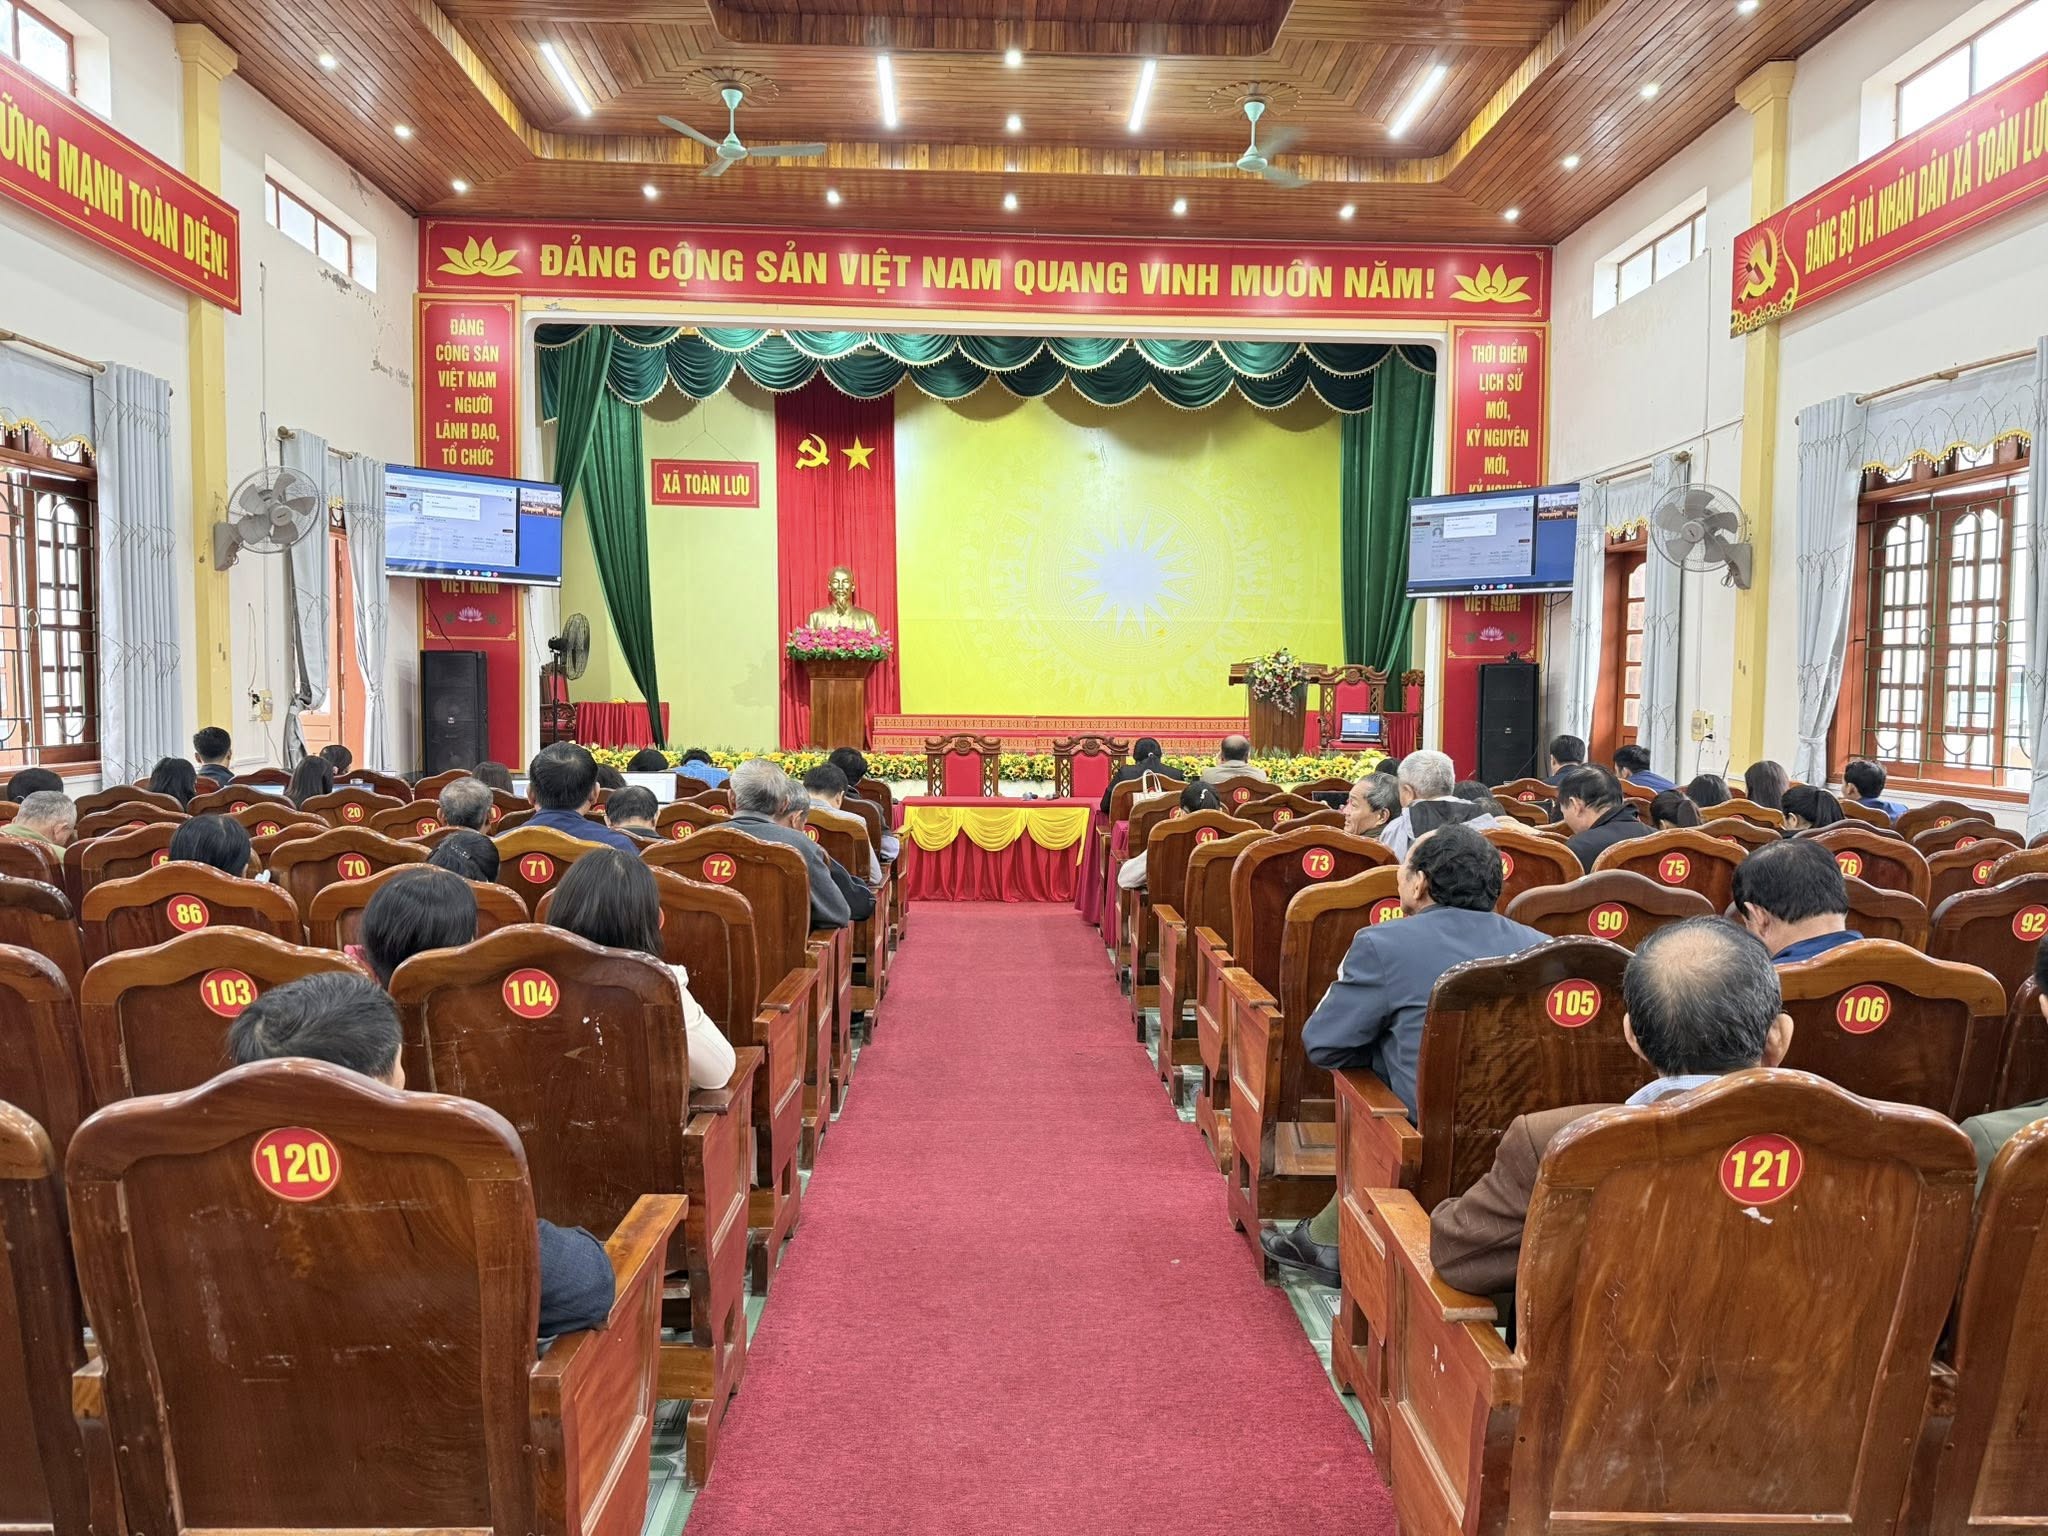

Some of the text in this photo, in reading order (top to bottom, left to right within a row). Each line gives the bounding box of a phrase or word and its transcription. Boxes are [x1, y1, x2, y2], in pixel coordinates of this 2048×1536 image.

[1805, 208, 1837, 275] ĐẢNG
[1839, 195, 1856, 263] BỘ
[1859, 185, 1874, 247] VÀ
[1877, 167, 1914, 238] NHÂN
[1918, 149, 1950, 217] DÂN
[1977, 108, 2020, 187] TOÀN
[2023, 91, 2048, 164] LƯ
[58, 136, 124, 222] MẠNH
[129, 180, 179, 253] TOÀN
[183, 214, 229, 280] DIỆN!
[539, 234, 1435, 300] ĐẢNG CỘNG SẢN VIỆT NAM QUANG VINH MUÔN NĂM!
[450, 313, 484, 337] ĐẢNG
[435, 340, 499, 364] CỘNG SẢN
[1471, 338, 1528, 364] THỜI ĐIỂM
[438, 367, 497, 390] VIỆT NAM
[1479, 368, 1523, 394] LỊCH SỬ
[454, 393, 493, 414] NGƯỜI
[1486, 397, 1511, 421] MỚI,
[435, 419, 500, 443] LÃNH ĐẠO,
[1466, 423, 1529, 448] KỶ NGUYÊN
[441, 441, 494, 466] TỔ CHỨC
[1484, 453, 1510, 477] MỚI,
[662, 470, 750, 496] XÃ TOÀN LƯU
[347, 807, 361, 818] 20
[1277, 811, 1290, 821] 26
[261, 826, 277, 836] 36
[421, 823, 436, 835] 37
[677, 826, 692, 838] 39
[1201, 832, 1214, 843] 41
[343, 860, 366, 877] 70
[526, 860, 547, 877] 71
[709, 860, 732, 877] 72
[1309, 854, 1329, 872] 73
[1666, 860, 1686, 877] 75
[1839, 859, 1857, 875] 76
[1978, 865, 1993, 879] 6
[176, 903, 203, 924] 86
[1597, 911, 1622, 931] 90
[2021, 913, 2046, 933] 92
[205, 978, 251, 1007] 103
[510, 977, 554, 1009] 104
[1552, 991, 1596, 1017] 105
[1842, 996, 1886, 1024] 106
[262, 1143, 331, 1184] 120
[1730, 1149, 1794, 1188] 121
